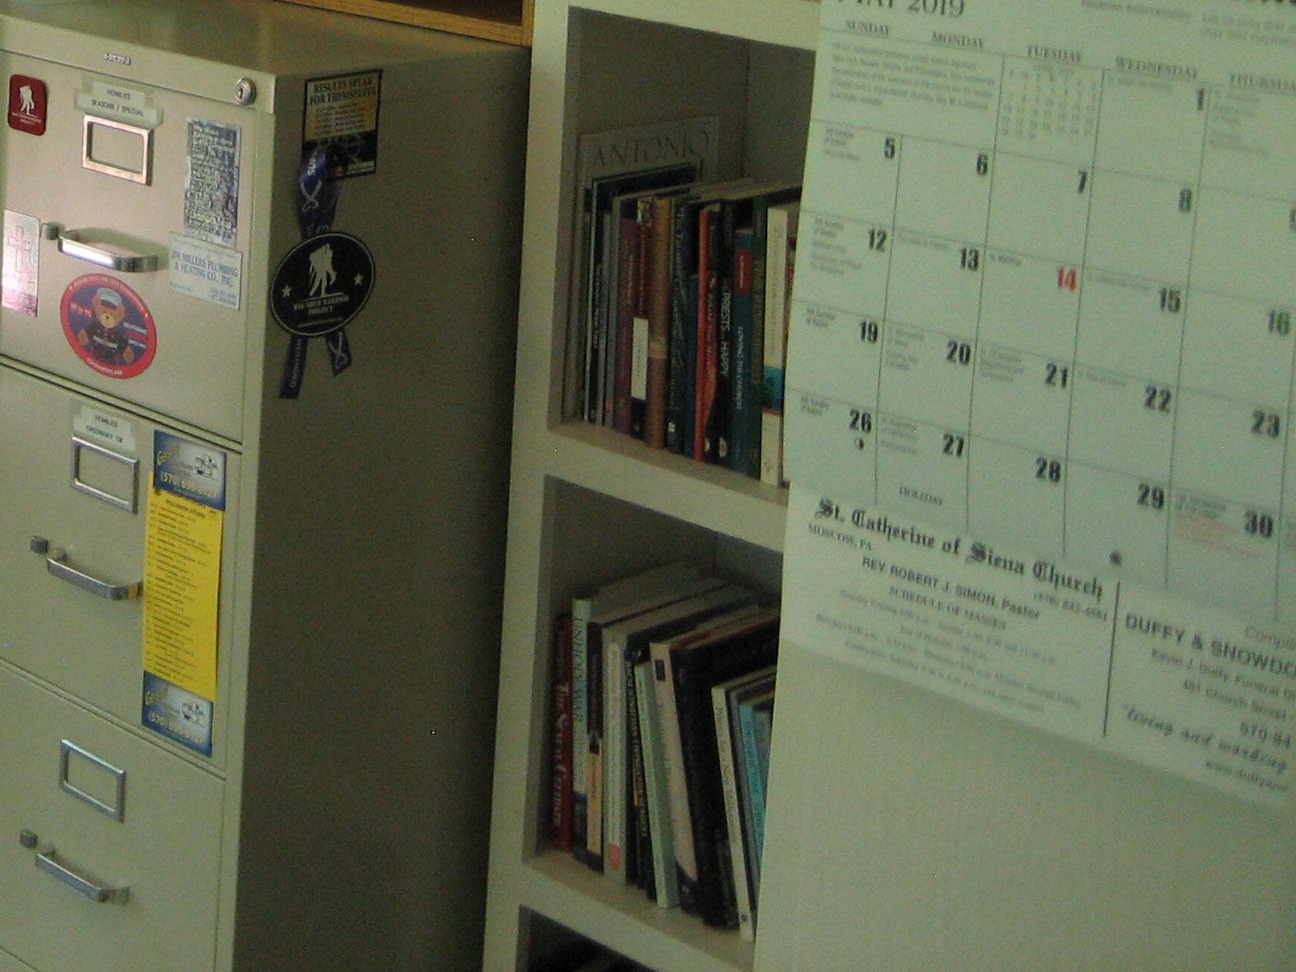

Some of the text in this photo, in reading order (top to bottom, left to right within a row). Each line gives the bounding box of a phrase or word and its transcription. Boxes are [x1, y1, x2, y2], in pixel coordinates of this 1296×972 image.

[846, 20, 1296, 94] SUNDAY MONDAY TUESDAY WEDNESDAY THURSDA
[309, 92, 326, 105] FOR
[1197, 88, 1204, 111] 1
[883, 139, 895, 159] 5
[976, 155, 988, 176] 6
[1077, 171, 1088, 194] 7
[1178, 188, 1192, 213] 8
[867, 229, 1291, 336] 12 13 14 15 16
[720, 292, 732, 377] PRIESTS HAPPY
[859, 322, 1281, 438] 19 20 21 22 23
[849, 409, 1274, 538] 26 27 28 29 30
[808, 523, 873, 552] MOSCOW, PA
[814, 497, 1103, 604] St. Catherine of Siena Church
[889, 560, 940, 591] ROBERT
[1001, 598, 1041, 621] Pastor
[889, 585, 1007, 631] SCHEDULE OF MASSES
[1125, 612, 1186, 644] DUFFY
[1211, 639, 1296, 679] SNOWDO
